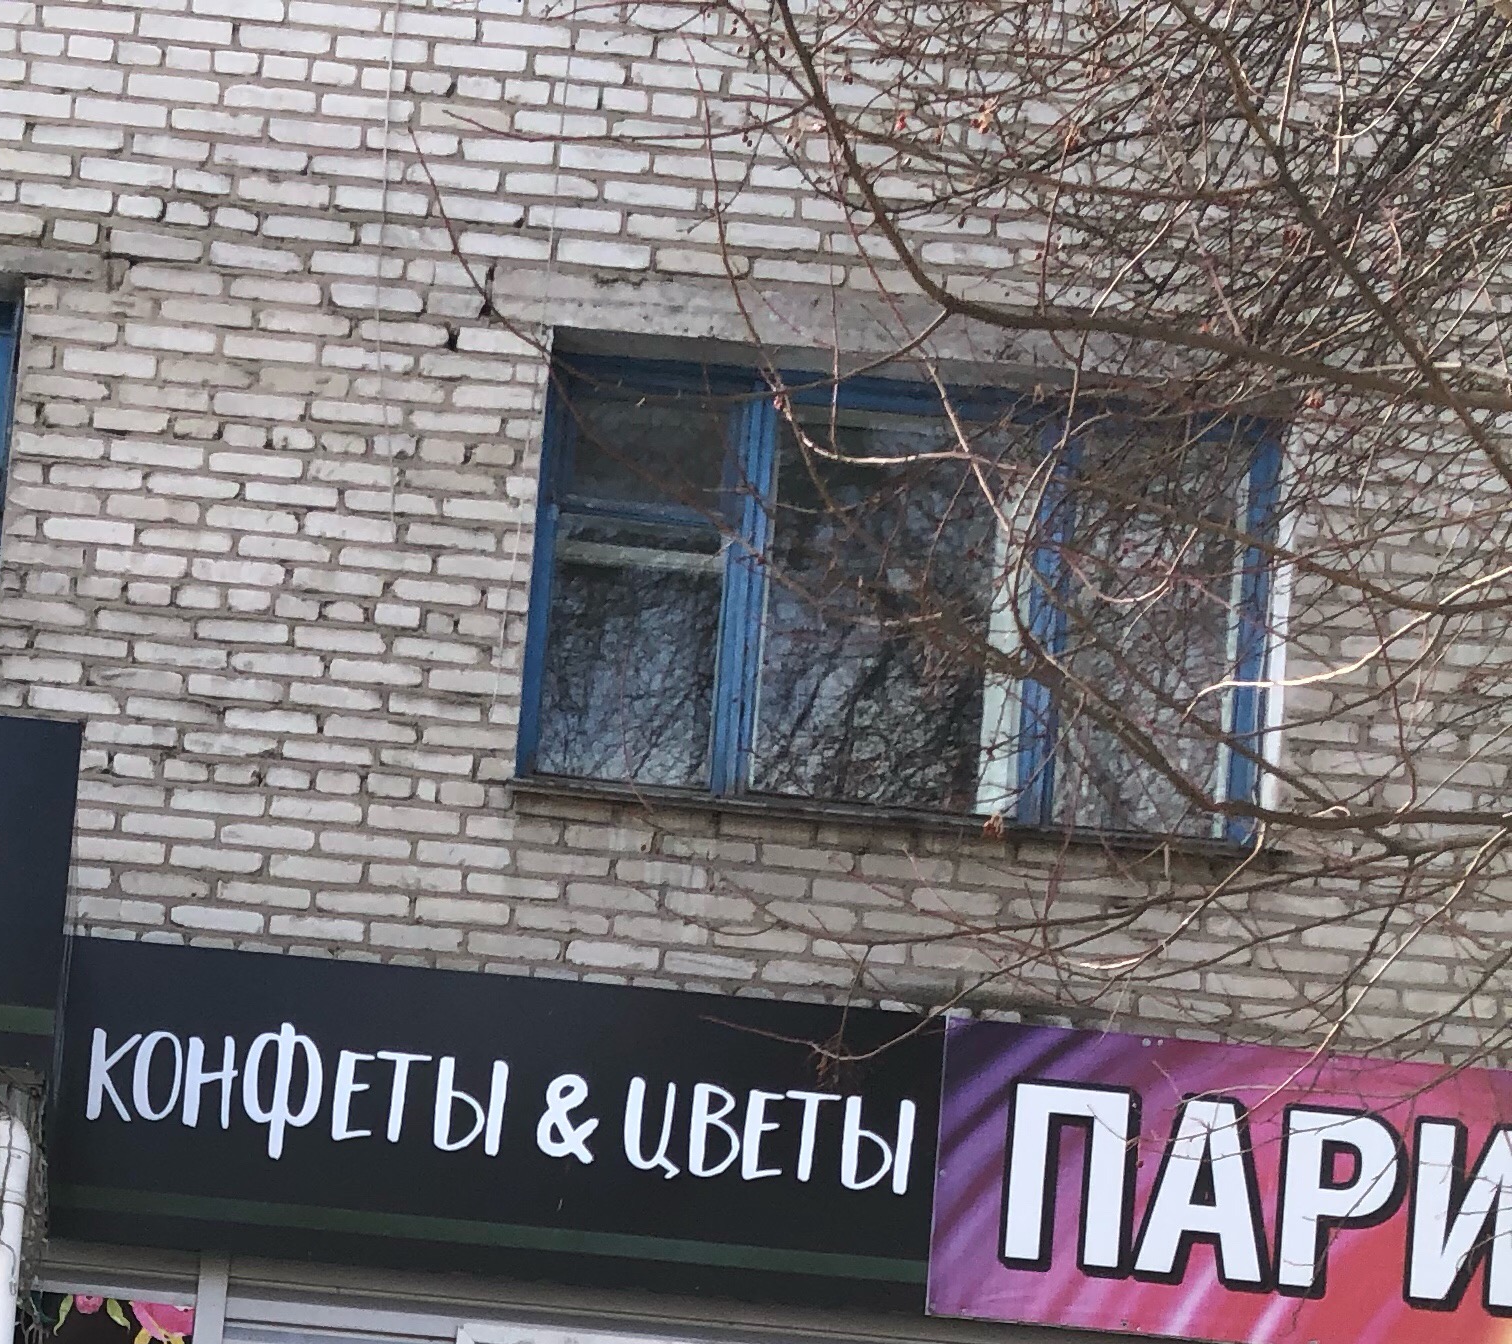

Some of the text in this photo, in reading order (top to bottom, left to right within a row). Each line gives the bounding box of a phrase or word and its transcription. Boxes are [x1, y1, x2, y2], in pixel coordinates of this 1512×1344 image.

[86, 1022, 916, 1195] КОНФЕТЫ & ЦВЕТЫ
